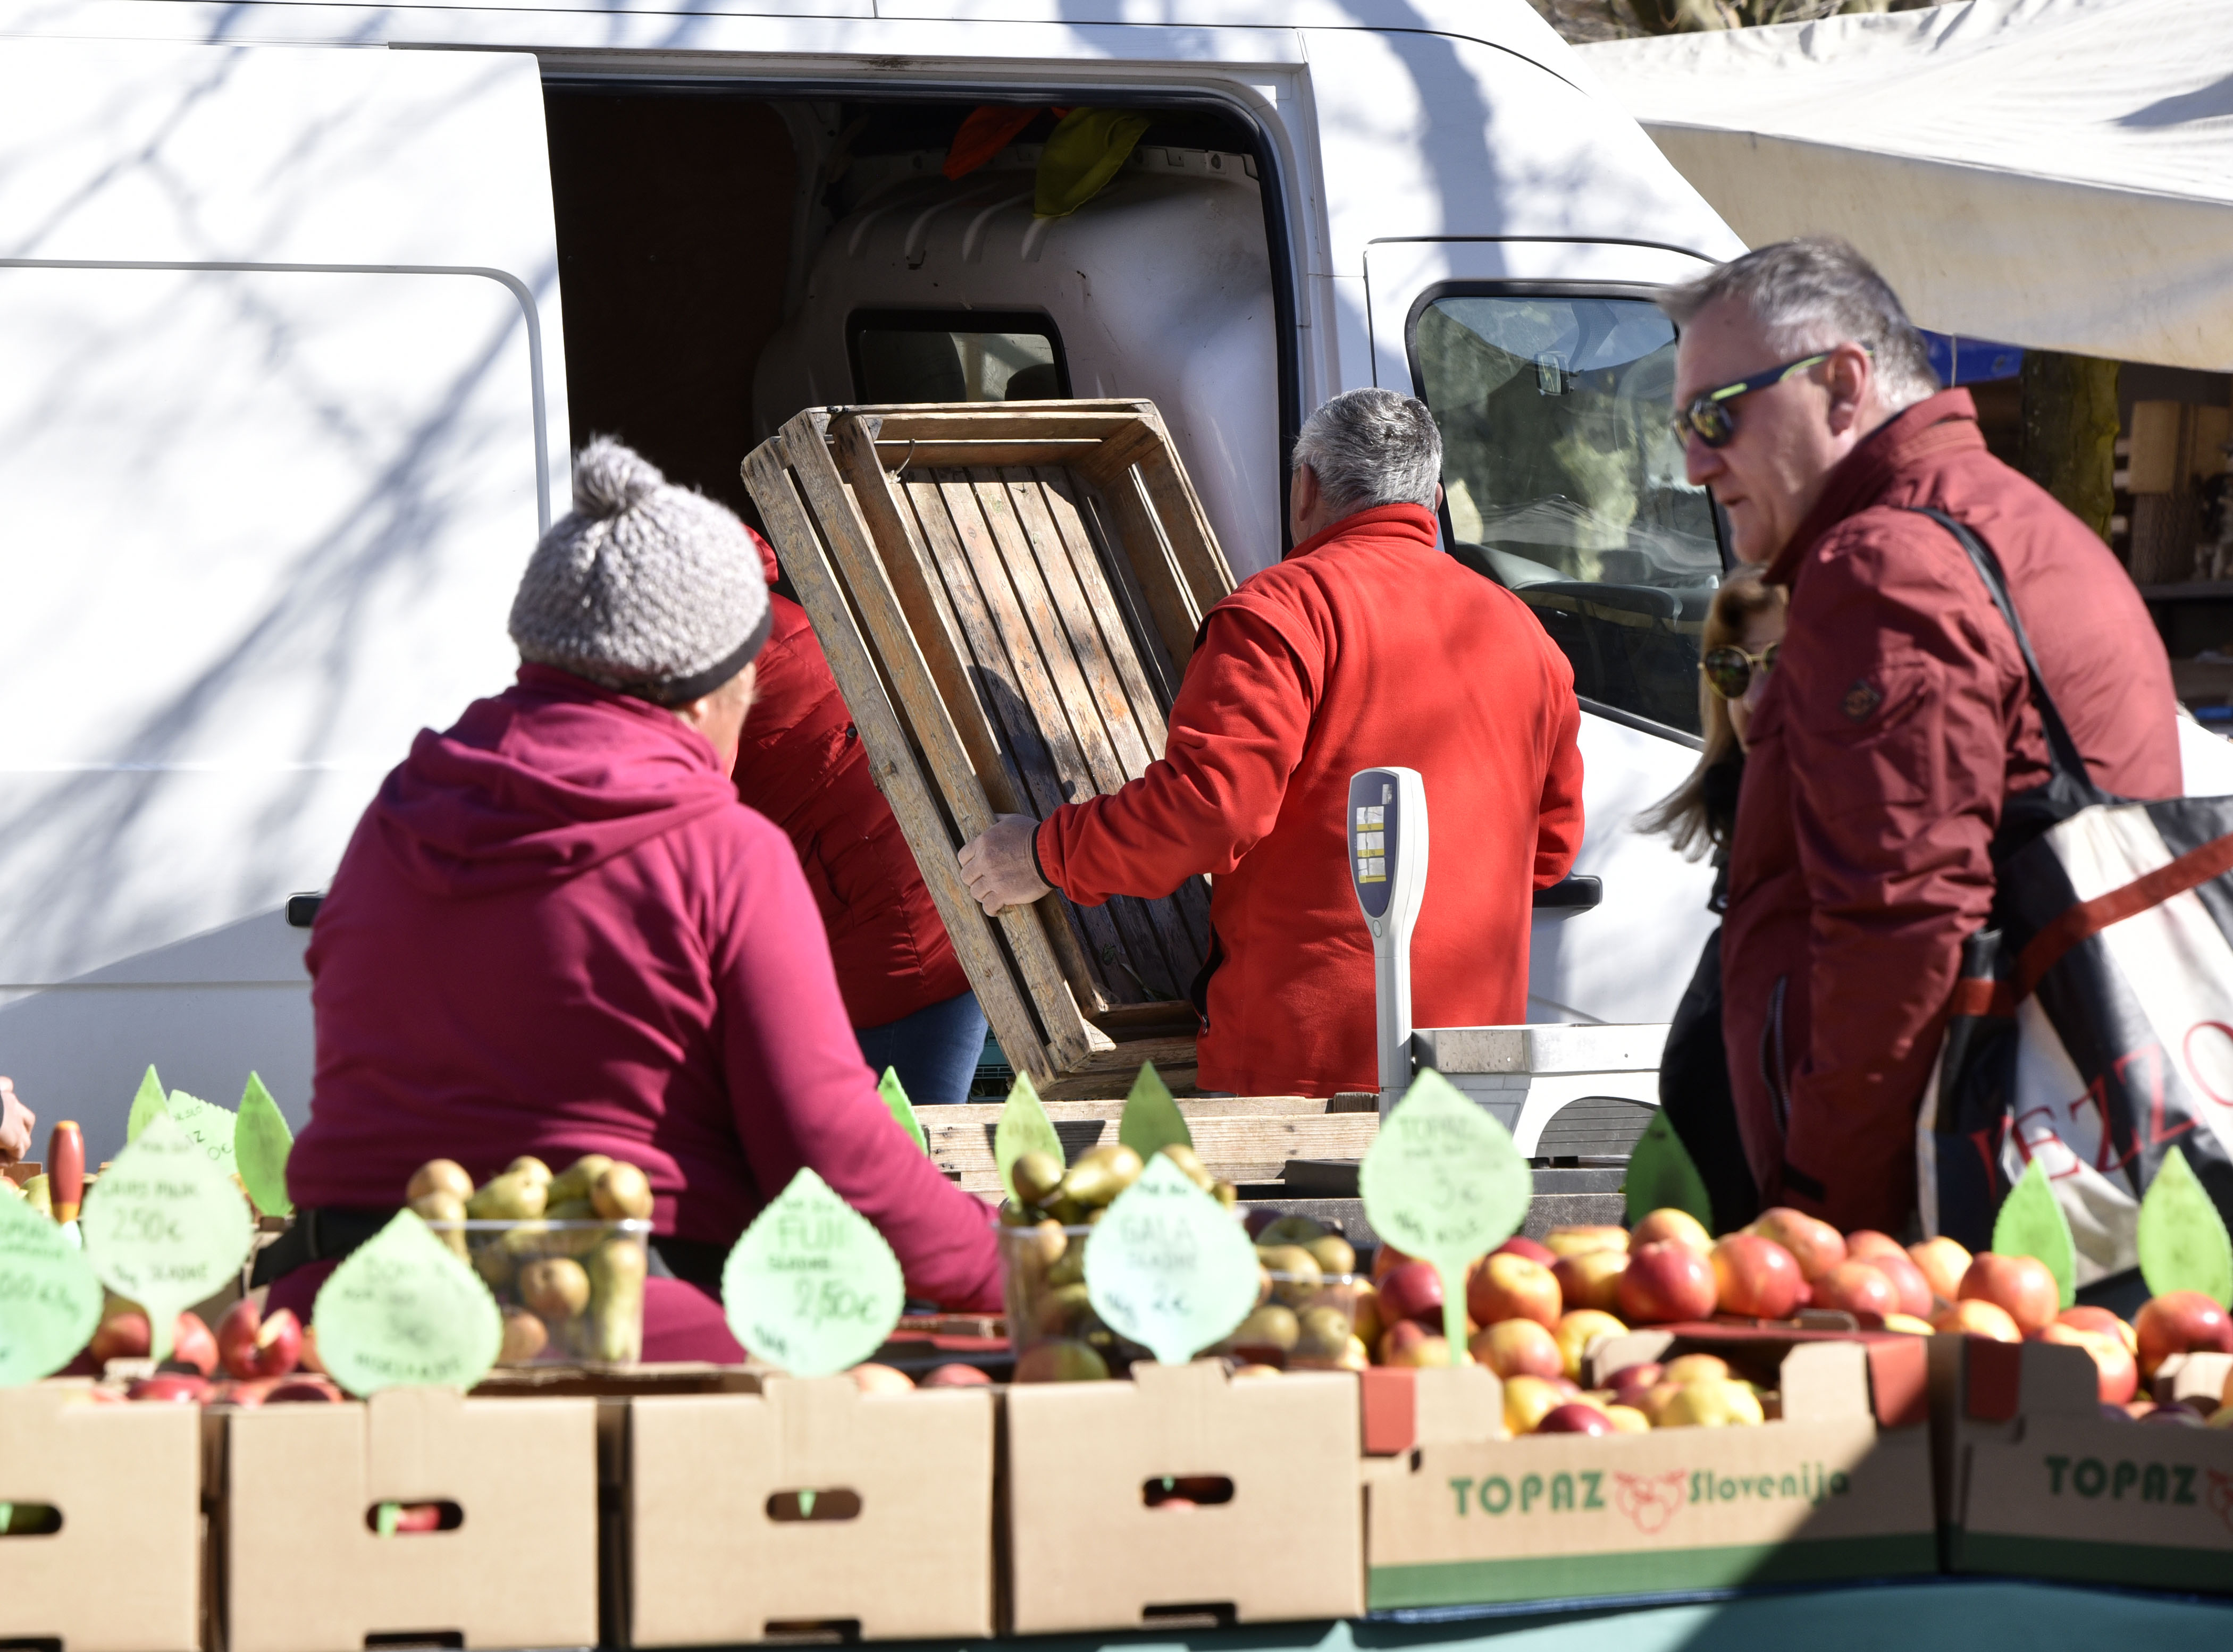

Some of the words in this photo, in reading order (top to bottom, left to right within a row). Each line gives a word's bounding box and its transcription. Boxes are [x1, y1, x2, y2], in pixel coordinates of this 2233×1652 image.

[1449, 1470, 1606, 1517] TOPAZ
[1688, 1462, 1850, 1507] Slovenija
[2045, 1454, 2198, 1505] TOPAZ
